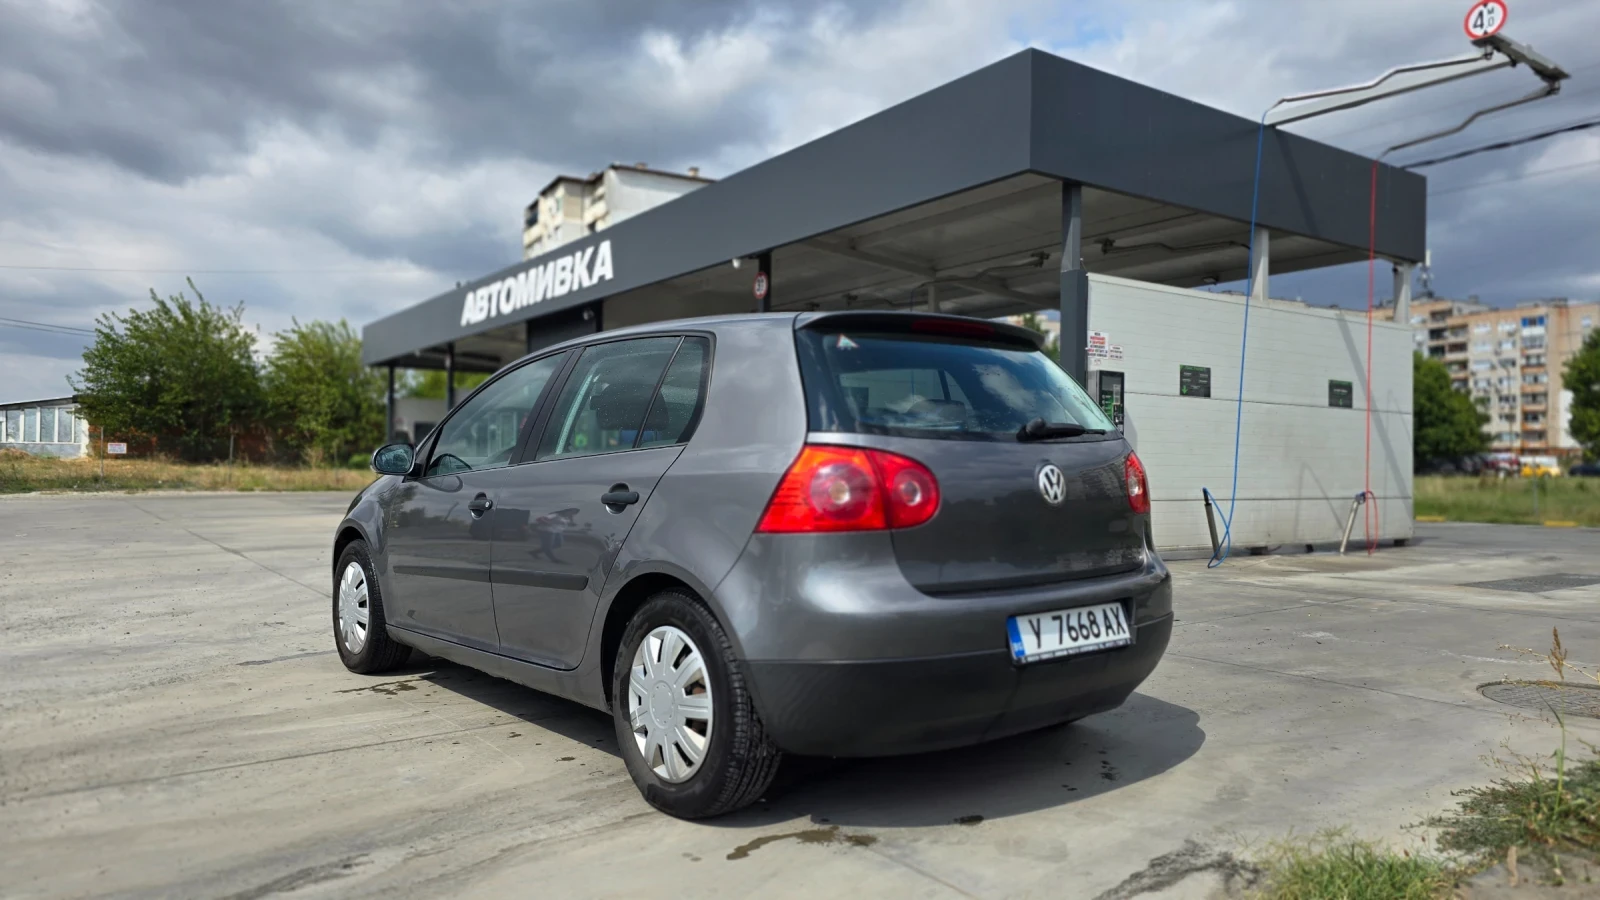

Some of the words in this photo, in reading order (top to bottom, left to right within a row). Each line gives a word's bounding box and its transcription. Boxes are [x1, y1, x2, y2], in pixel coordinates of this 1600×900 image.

[1473, 10, 1485, 29] 4
[460, 240, 614, 327] АВТОМИВКА
[1051, 610, 1101, 645] 7668
[1102, 606, 1126, 636] AX
